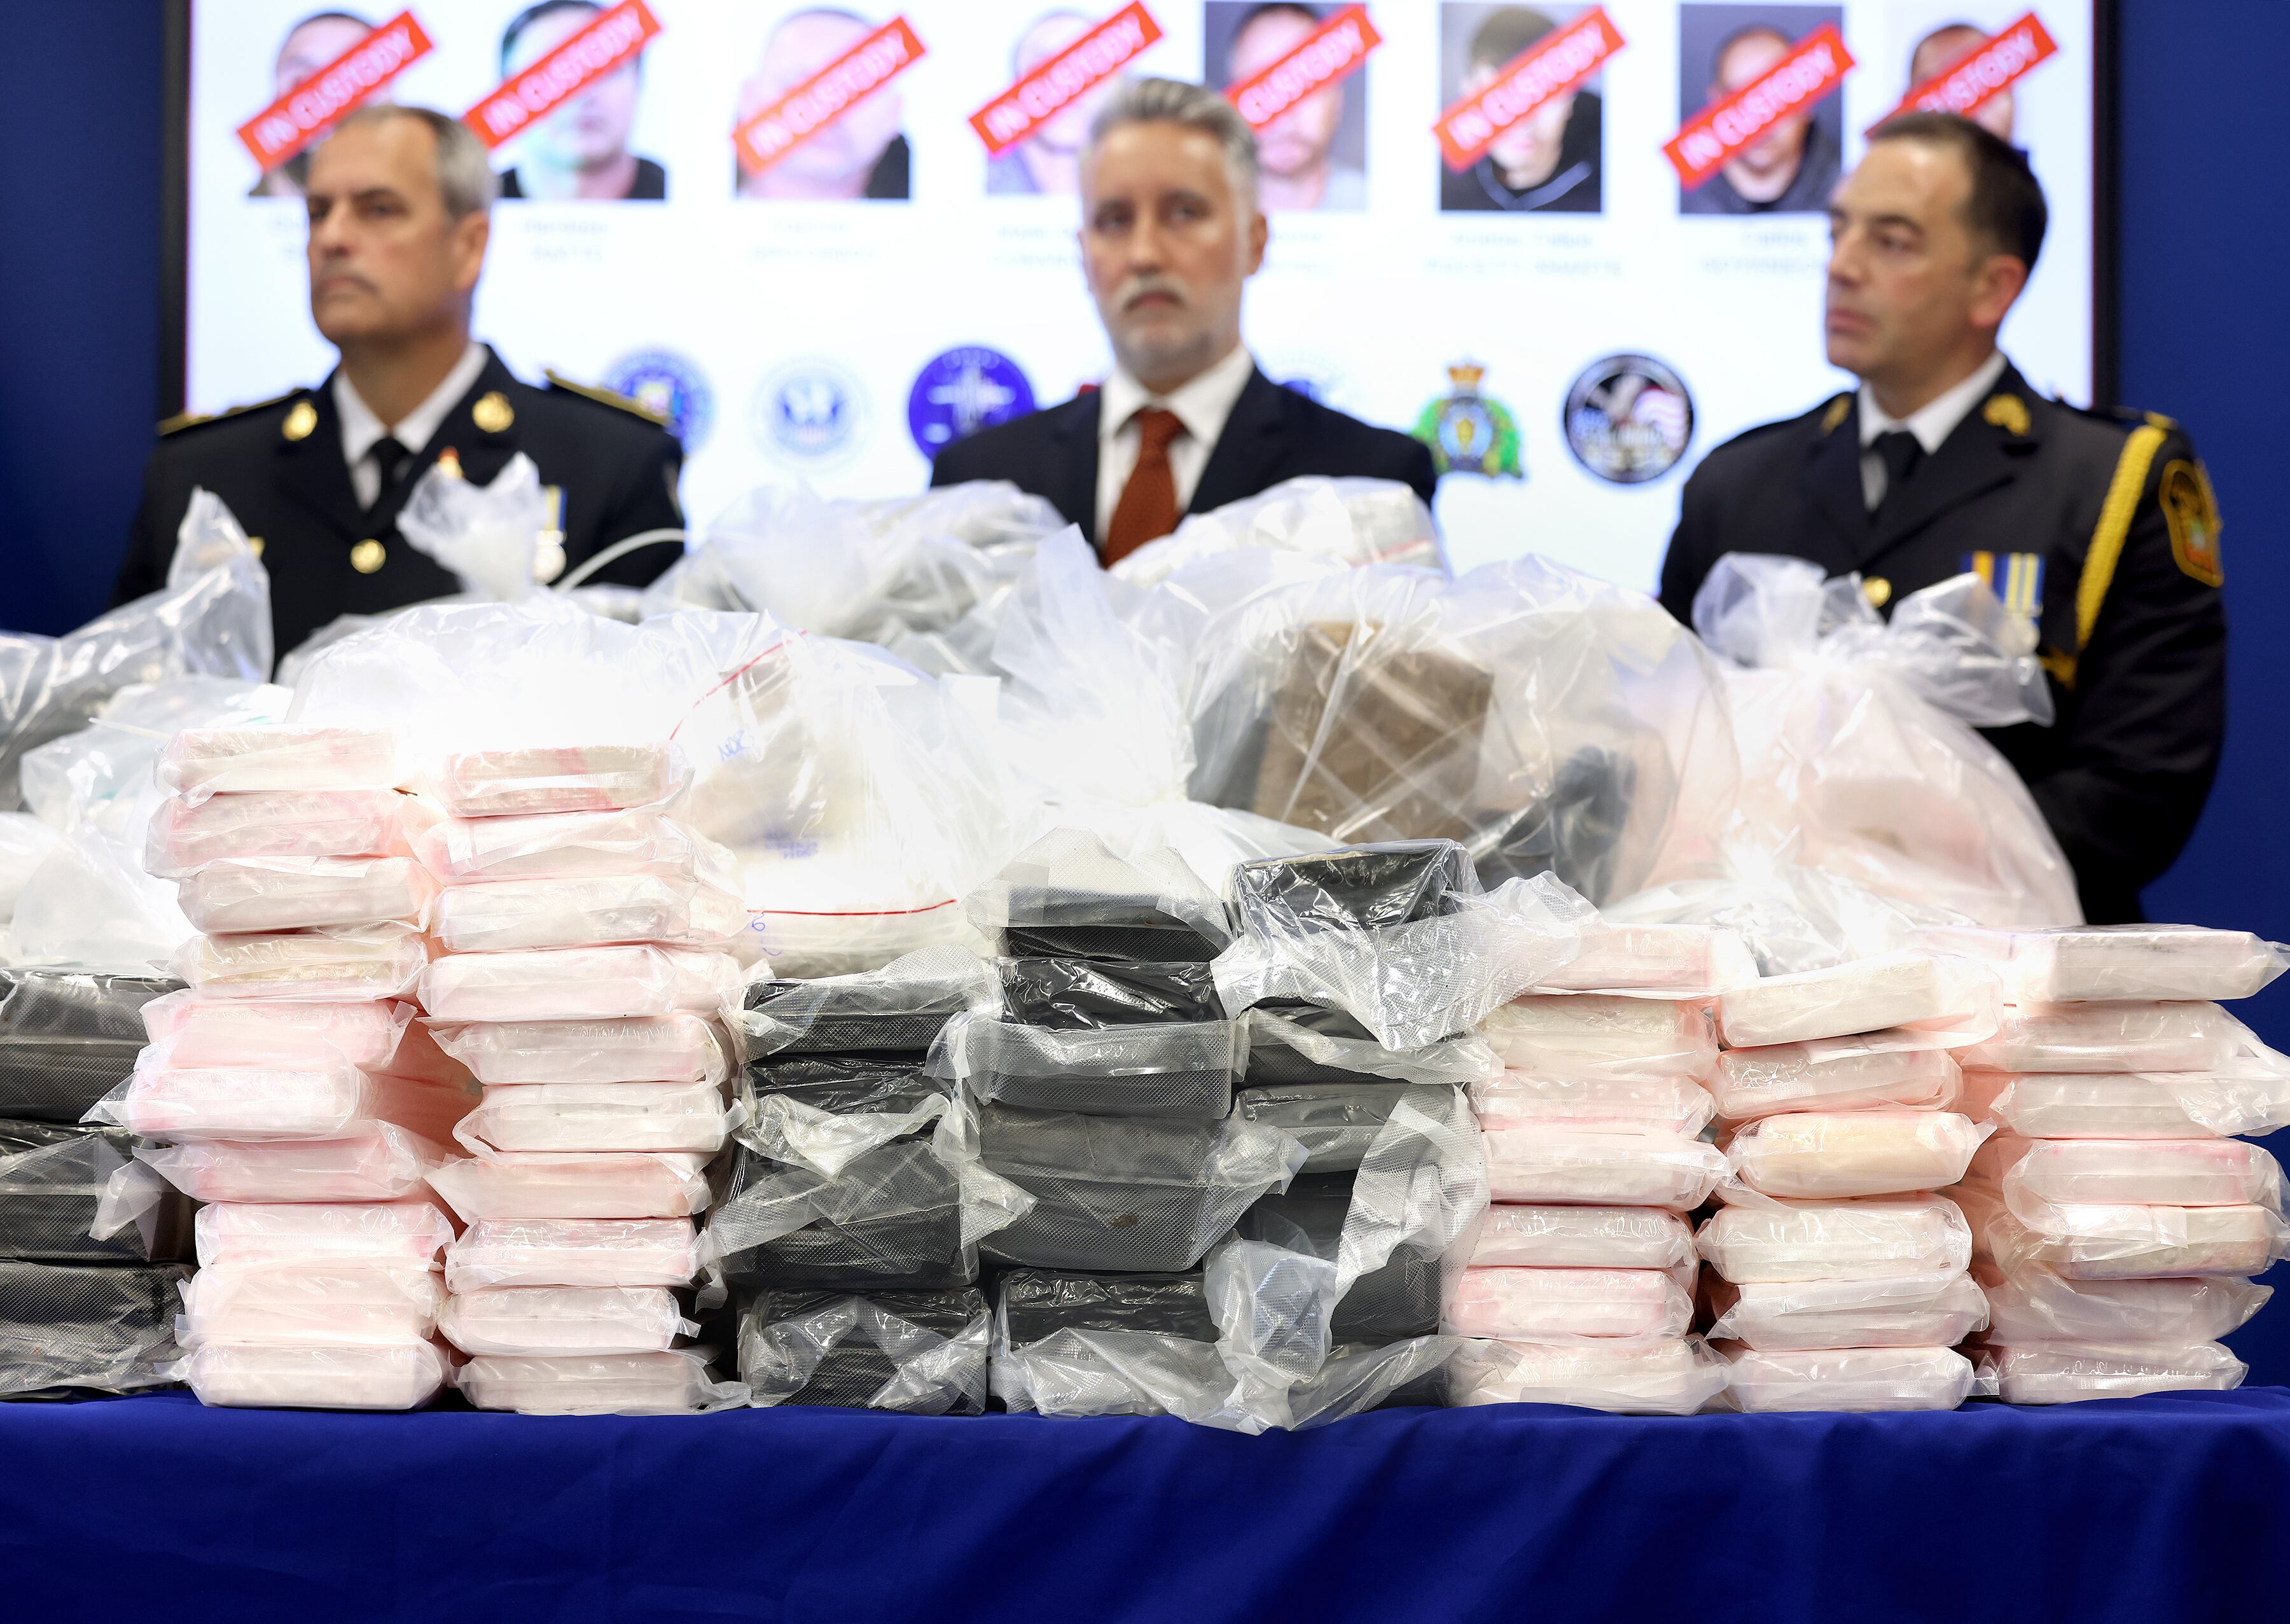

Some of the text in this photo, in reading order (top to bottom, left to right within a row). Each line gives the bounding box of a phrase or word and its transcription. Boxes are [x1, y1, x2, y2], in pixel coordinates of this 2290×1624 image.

[254, 25, 415, 155] IN CUSTODY
[483, 6, 644, 136] IN CUSTODY
[747, 30, 908, 159] IN CUSTODY
[984, 13, 1145, 143] IN CUSTODY
[1237, 18, 1364, 124] CUSTODY
[1447, 21, 1607, 151] IN CUSTODY
[1679, 43, 1836, 170] IN CUSTODY
